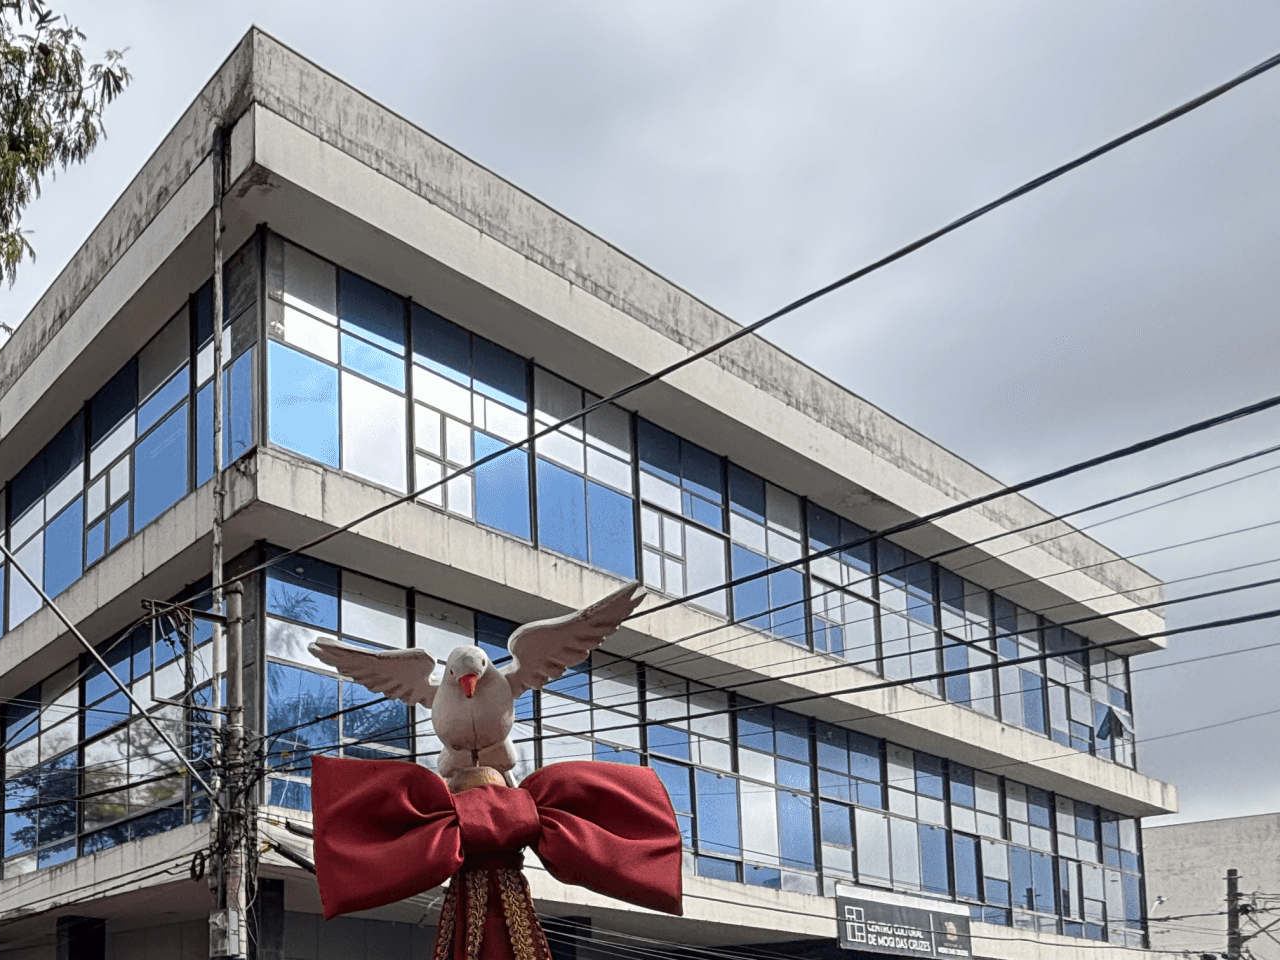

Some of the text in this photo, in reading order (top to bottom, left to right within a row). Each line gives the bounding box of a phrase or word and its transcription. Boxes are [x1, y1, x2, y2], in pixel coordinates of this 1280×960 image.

[867, 934, 878, 946] DE
[878, 936, 895, 948] MOGI
[895, 937, 908, 949] DAS
[908, 939, 932, 952] CRUZES
